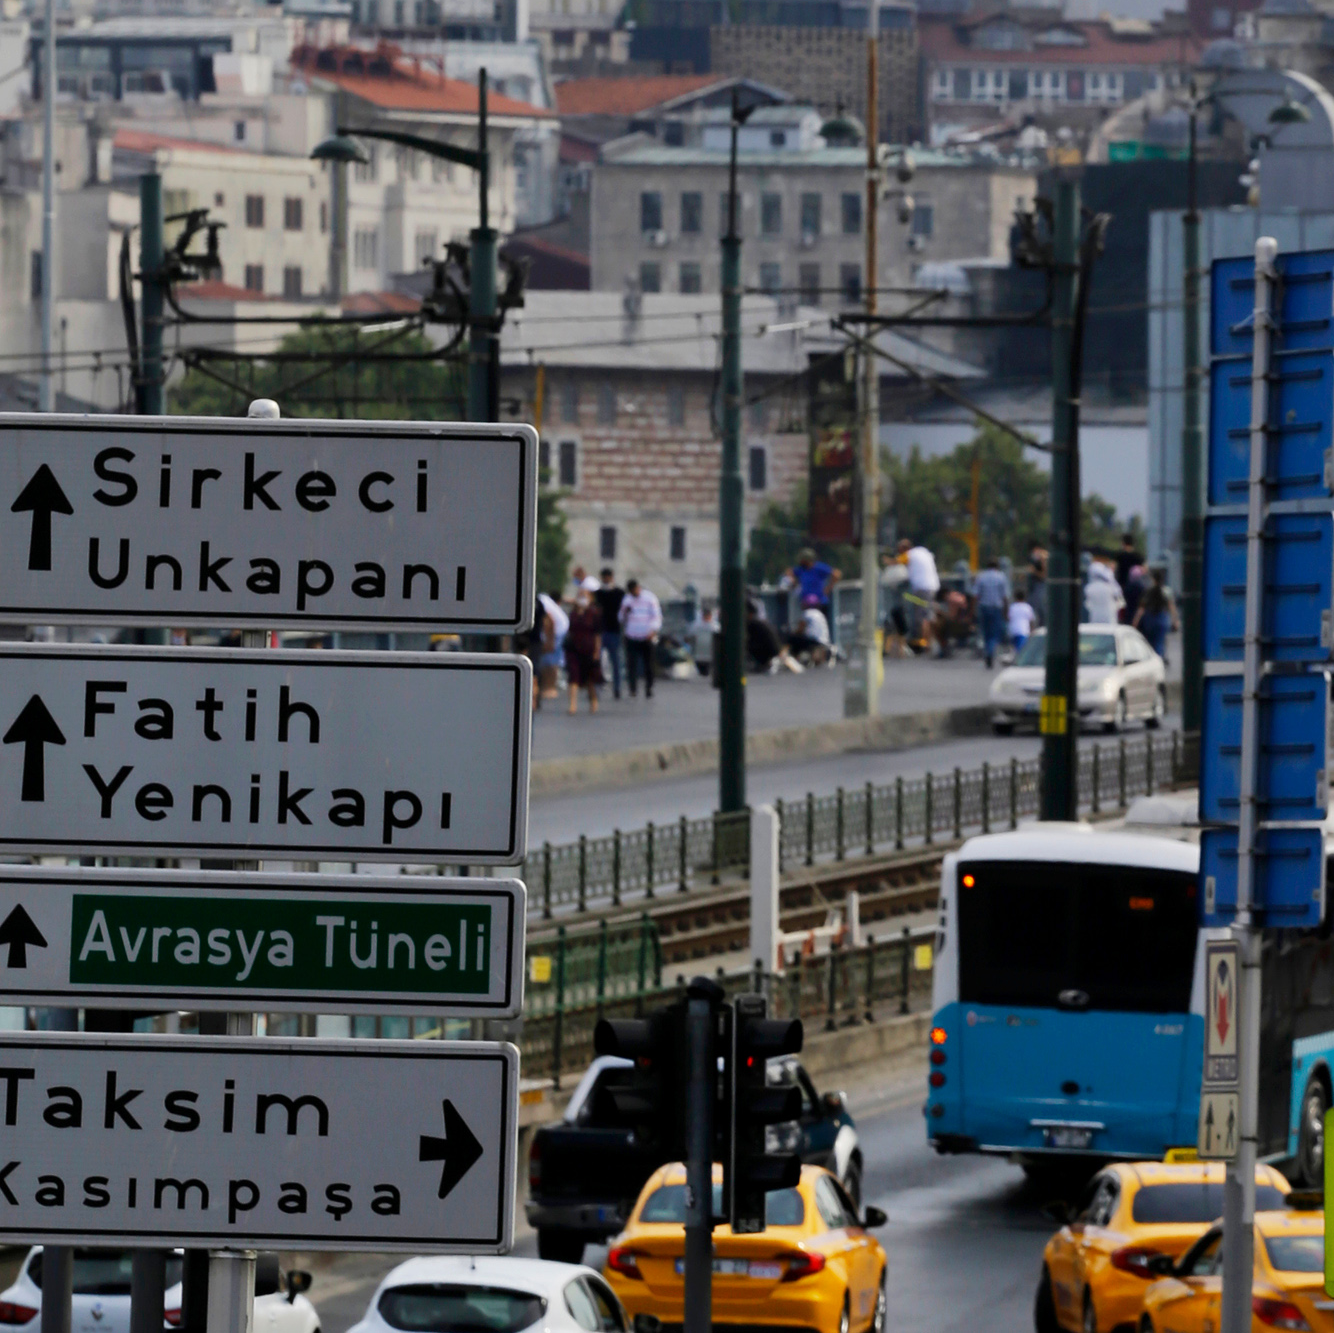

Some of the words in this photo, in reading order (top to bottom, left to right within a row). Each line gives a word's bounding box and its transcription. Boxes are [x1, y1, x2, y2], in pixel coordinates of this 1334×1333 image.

[93, 447, 428, 513] Sirkeci
[88, 538, 467, 611] Unkapanı
[84, 681, 320, 743] Fatih
[83, 764, 452, 844] Yenikapı
[79, 910, 294, 980] Avrasya
[316, 916, 485, 970] Tüneli
[0, 1068, 329, 1136] Taksim
